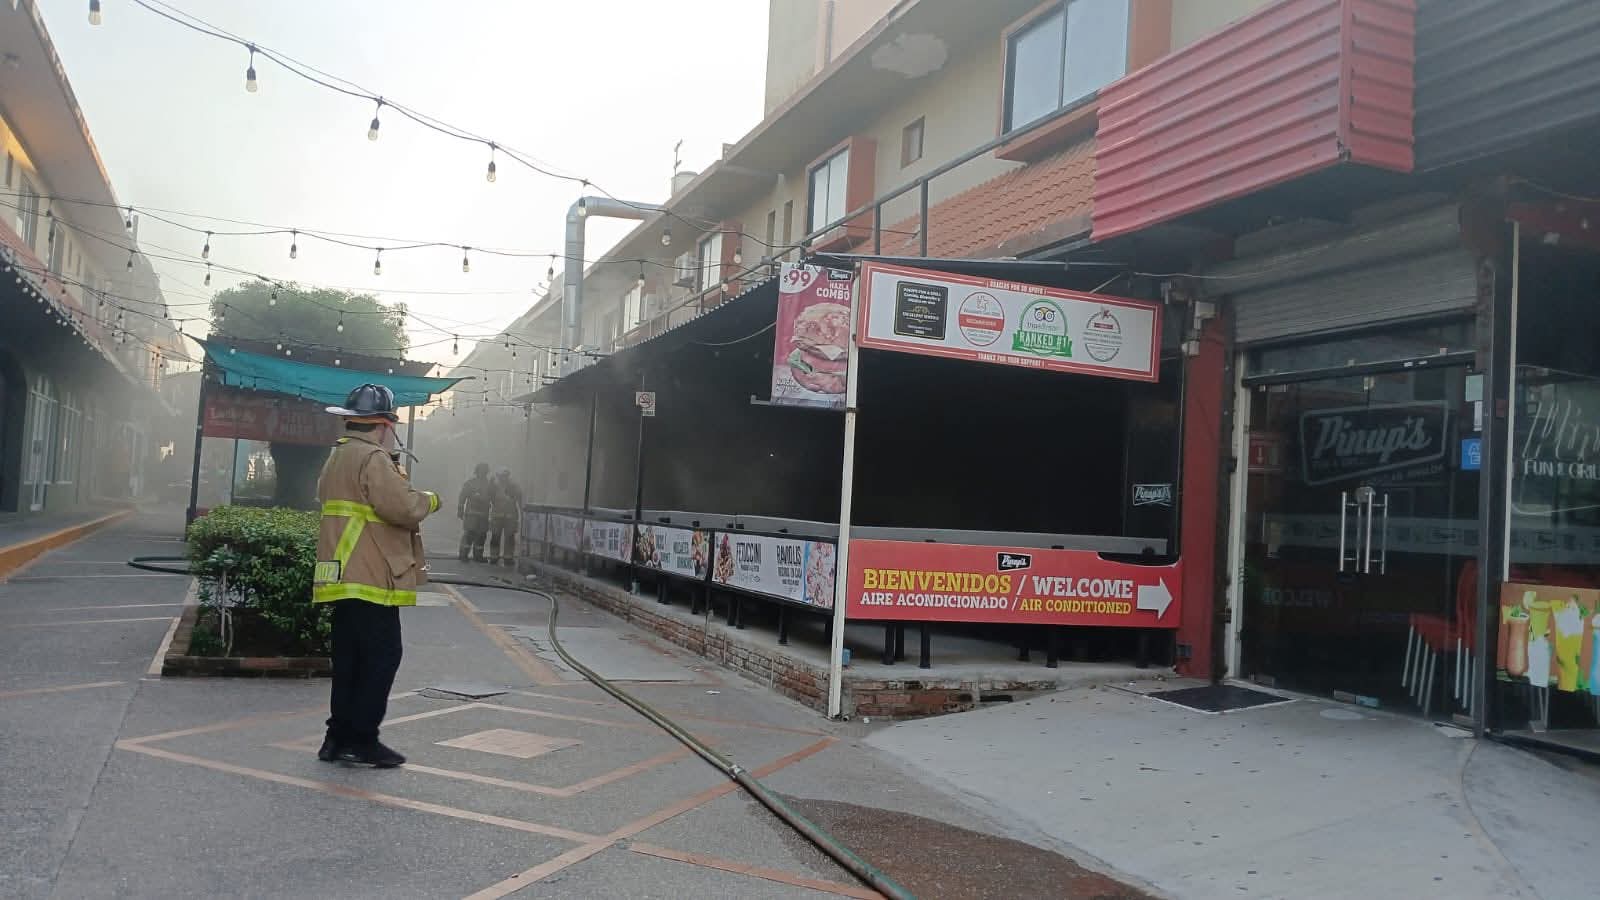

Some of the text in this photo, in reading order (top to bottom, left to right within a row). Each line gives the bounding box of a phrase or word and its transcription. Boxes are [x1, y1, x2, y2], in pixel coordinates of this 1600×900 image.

[816, 287, 850, 300] COMBO
[829, 282, 849, 290] HAZLA
[1020, 331, 1054, 346] RANKED
[1057, 335, 1067, 347] #1
[863, 568, 1011, 593] BIENVENIDOS
[1032, 575, 1134, 599] WELCOME
[860, 592, 894, 606] AIRE
[896, 593, 1008, 609] ACONDICIONADO
[1020, 599, 1042, 611] AIR
[1045, 599, 1132, 614] CONDITIONED
